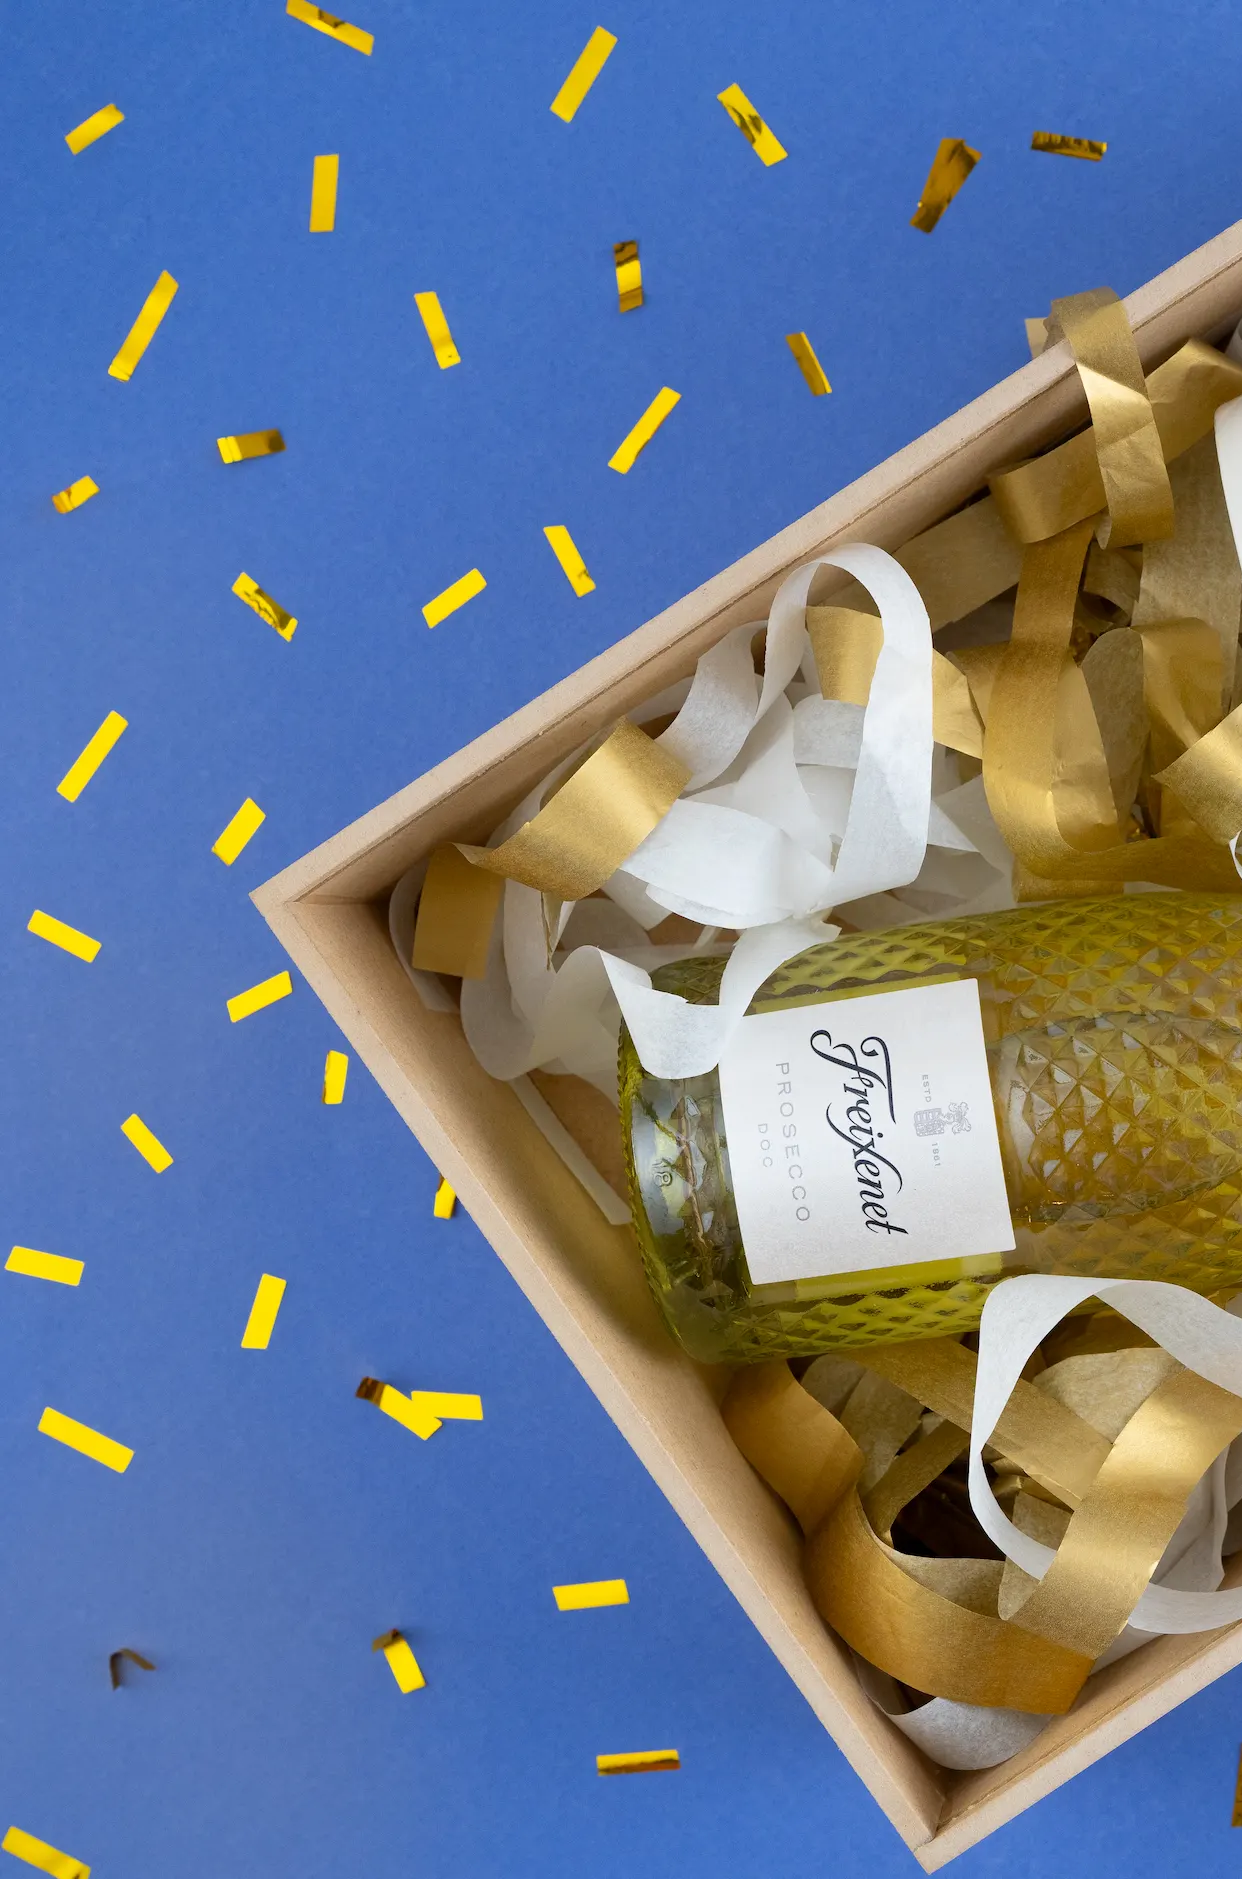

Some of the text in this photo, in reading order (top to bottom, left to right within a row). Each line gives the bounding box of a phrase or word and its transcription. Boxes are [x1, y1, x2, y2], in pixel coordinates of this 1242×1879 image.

[810, 1029, 909, 1234] Freixenet
[921, 1074, 932, 1103] ESTD
[758, 1124, 773, 1167] DOC
[775, 1062, 810, 1221] PROSECCO
